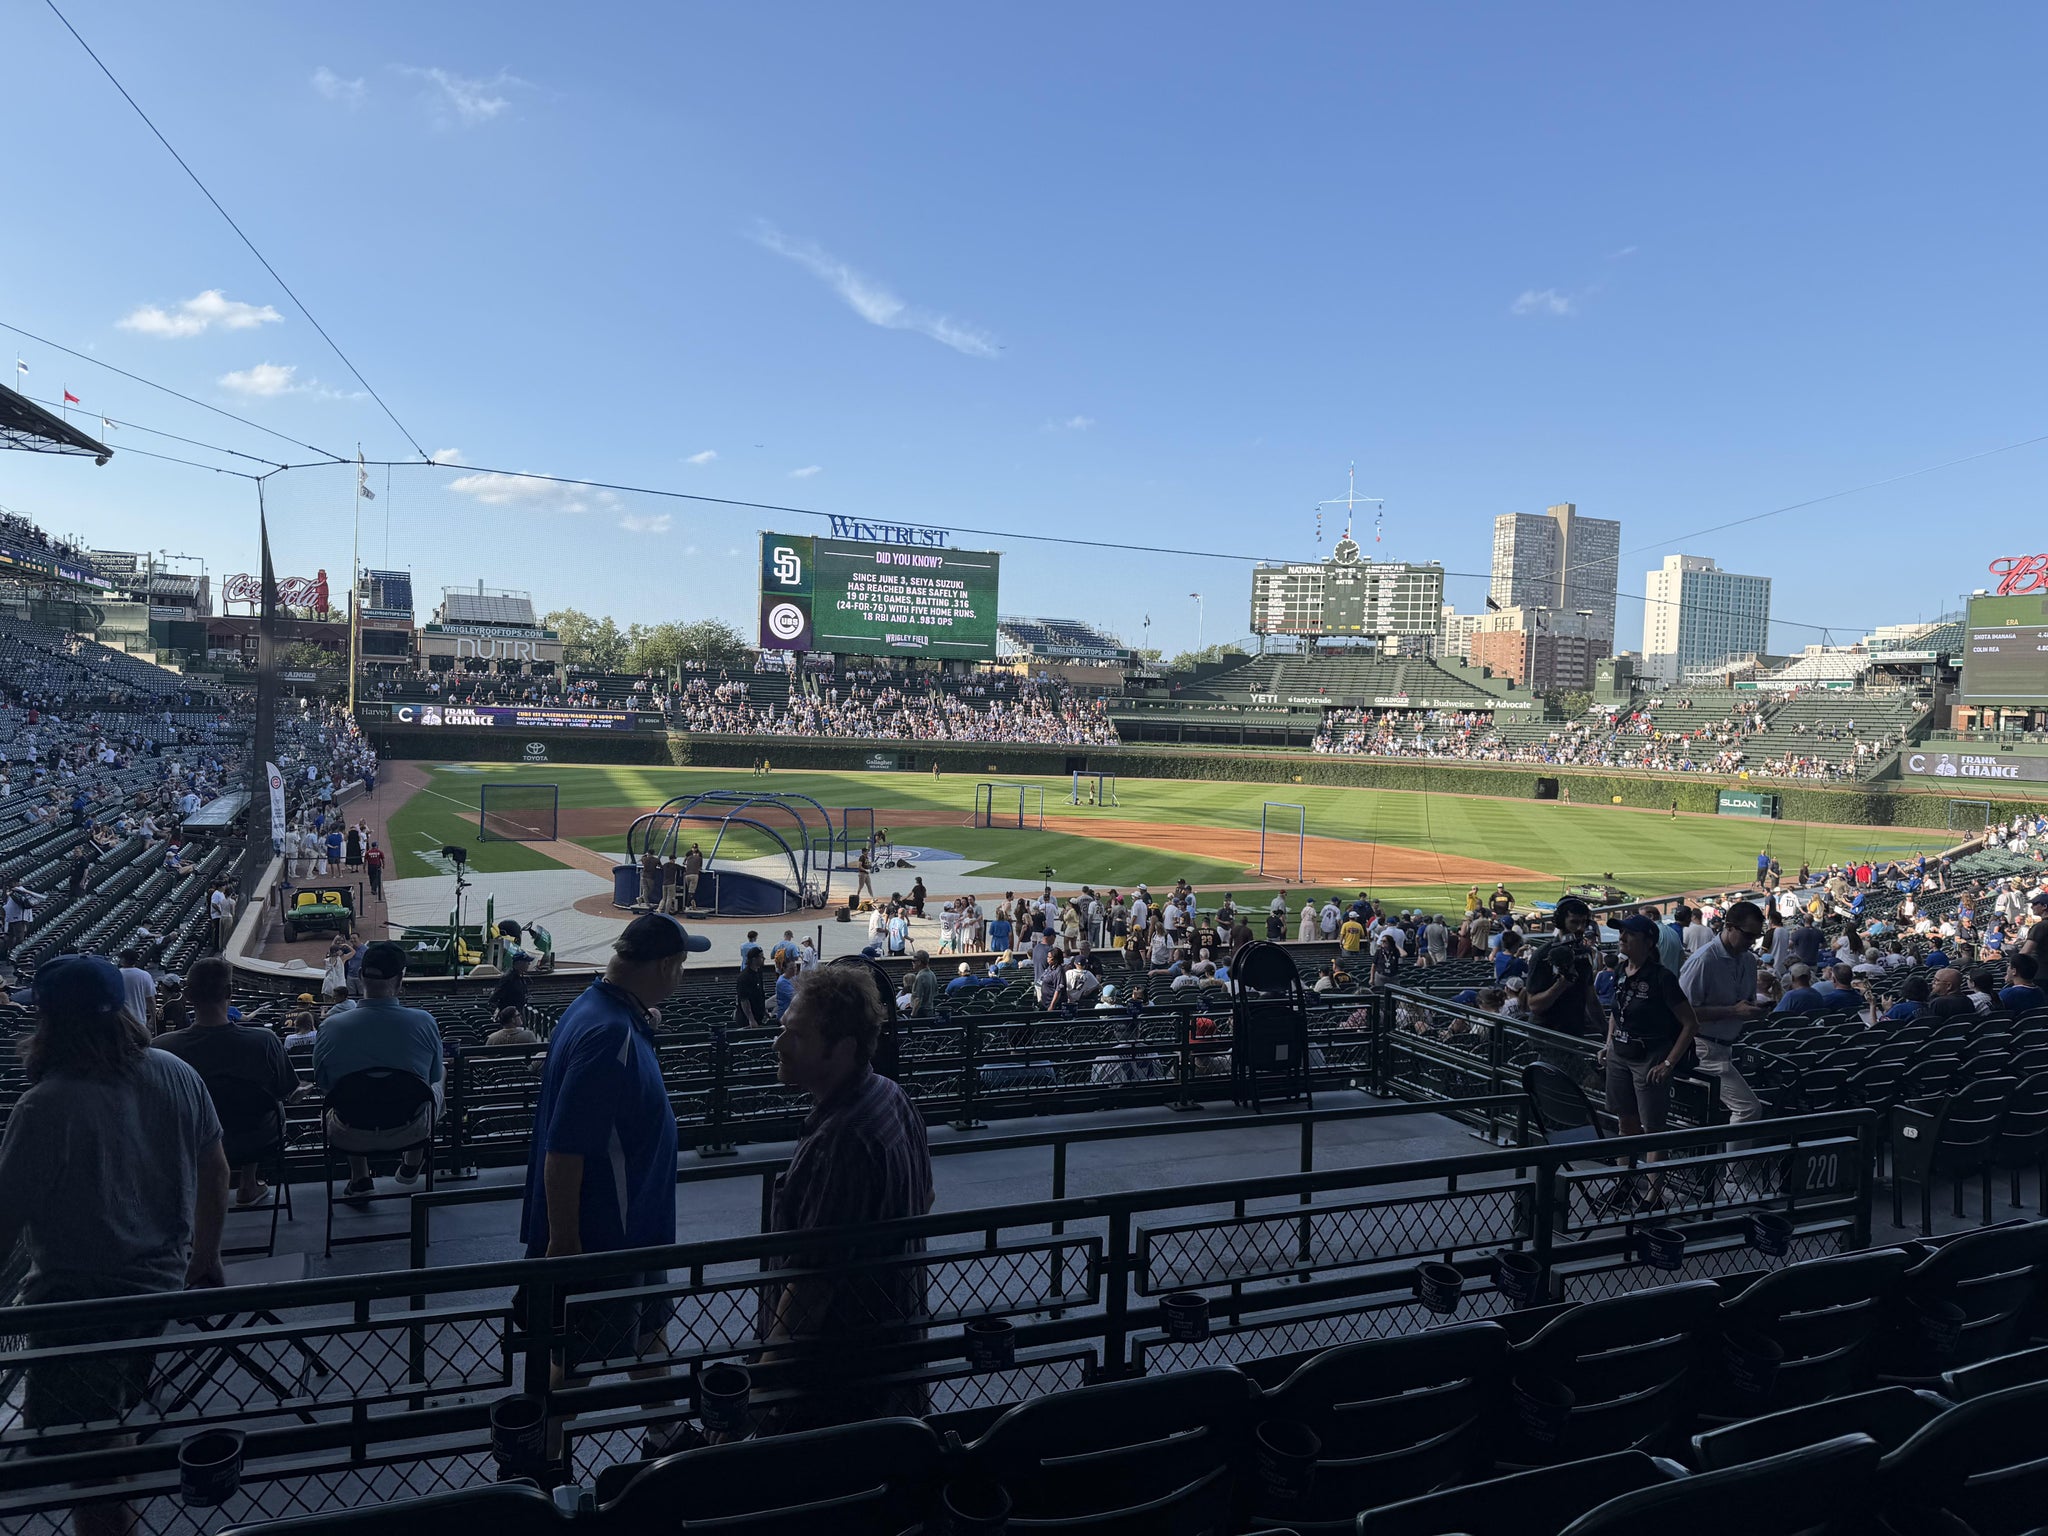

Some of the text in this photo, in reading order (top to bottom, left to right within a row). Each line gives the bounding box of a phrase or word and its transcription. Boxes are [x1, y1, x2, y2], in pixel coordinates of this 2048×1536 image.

[828, 514, 950, 547] WINTRUST
[773, 546, 801, 585] SD
[876, 551, 943, 568] DID YOU KNOW?
[1288, 566, 1326, 574] NATIONAL
[852, 572, 964, 588] SINCE JUNE 3, SEIYA SUZUKI
[222, 573, 328, 608] CocaCola
[848, 582, 968, 598] HAS REACHED BASE SAFELY IN
[846, 592, 969, 608] 19 OF 21 GAMES, BATTING .316
[836, 601, 977, 619] (24-FOR-76) WITH FIVE HOME RUNS,
[863, 612, 953, 626] 18 RBI AND A .983 OPS
[442, 624, 544, 638] WRIGLEYROOFTOPS.COM
[885, 633, 929, 646] WRIGLEY FIELD
[1047, 646, 1118, 656] WRIGLEYROOFTOPS.COM
[1250, 694, 1278, 703] YETI
[1495, 701, 1531, 709] Advocate
[361, 707, 390, 717] Harvey
[445, 708, 475, 716] FRANK
[444, 716, 494, 726] CHANCE
[1961, 755, 1997, 765] FRANK
[1961, 765, 2019, 778] CHANCE
[1201, 936, 1212, 946] 23
[1806, 1153, 1838, 1190] 220
